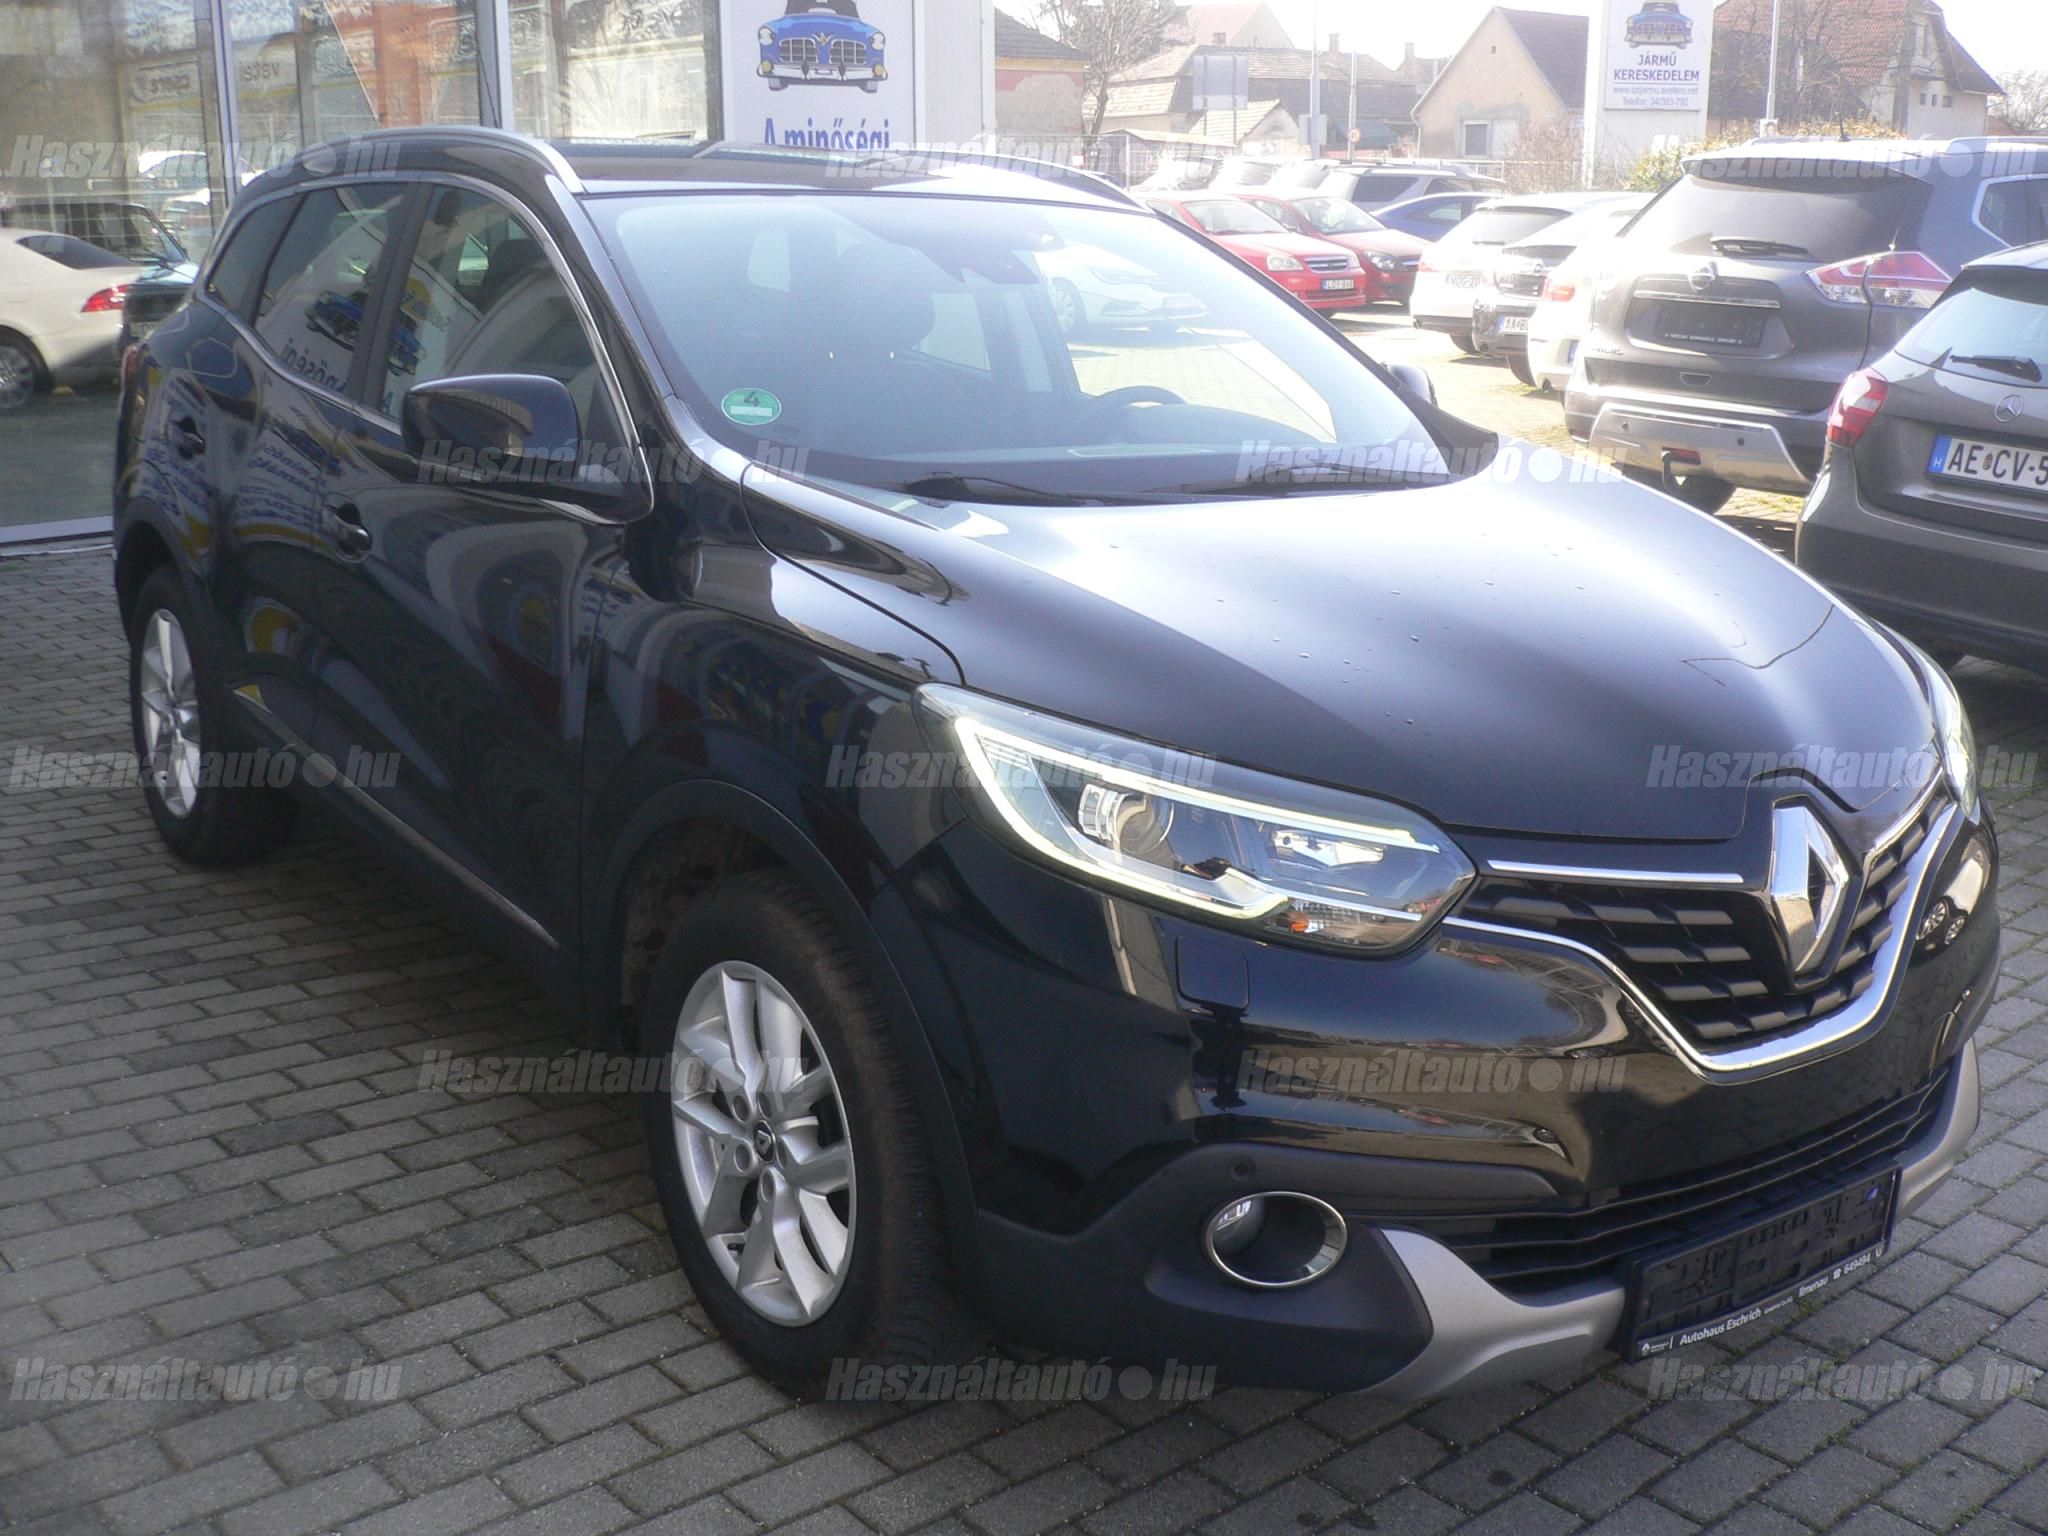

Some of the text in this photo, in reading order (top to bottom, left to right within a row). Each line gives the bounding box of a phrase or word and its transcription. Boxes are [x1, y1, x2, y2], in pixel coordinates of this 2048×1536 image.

[1638, 50, 1677, 66] JÁRMŰ
[1613, 69, 1700, 81] KERESKEDELEM
[743, 391, 761, 407] 4
[1947, 441, 1985, 475] AE
[1679, 1325, 1725, 1346] Autohaus
[1726, 1307, 1761, 1330] Eschrich
